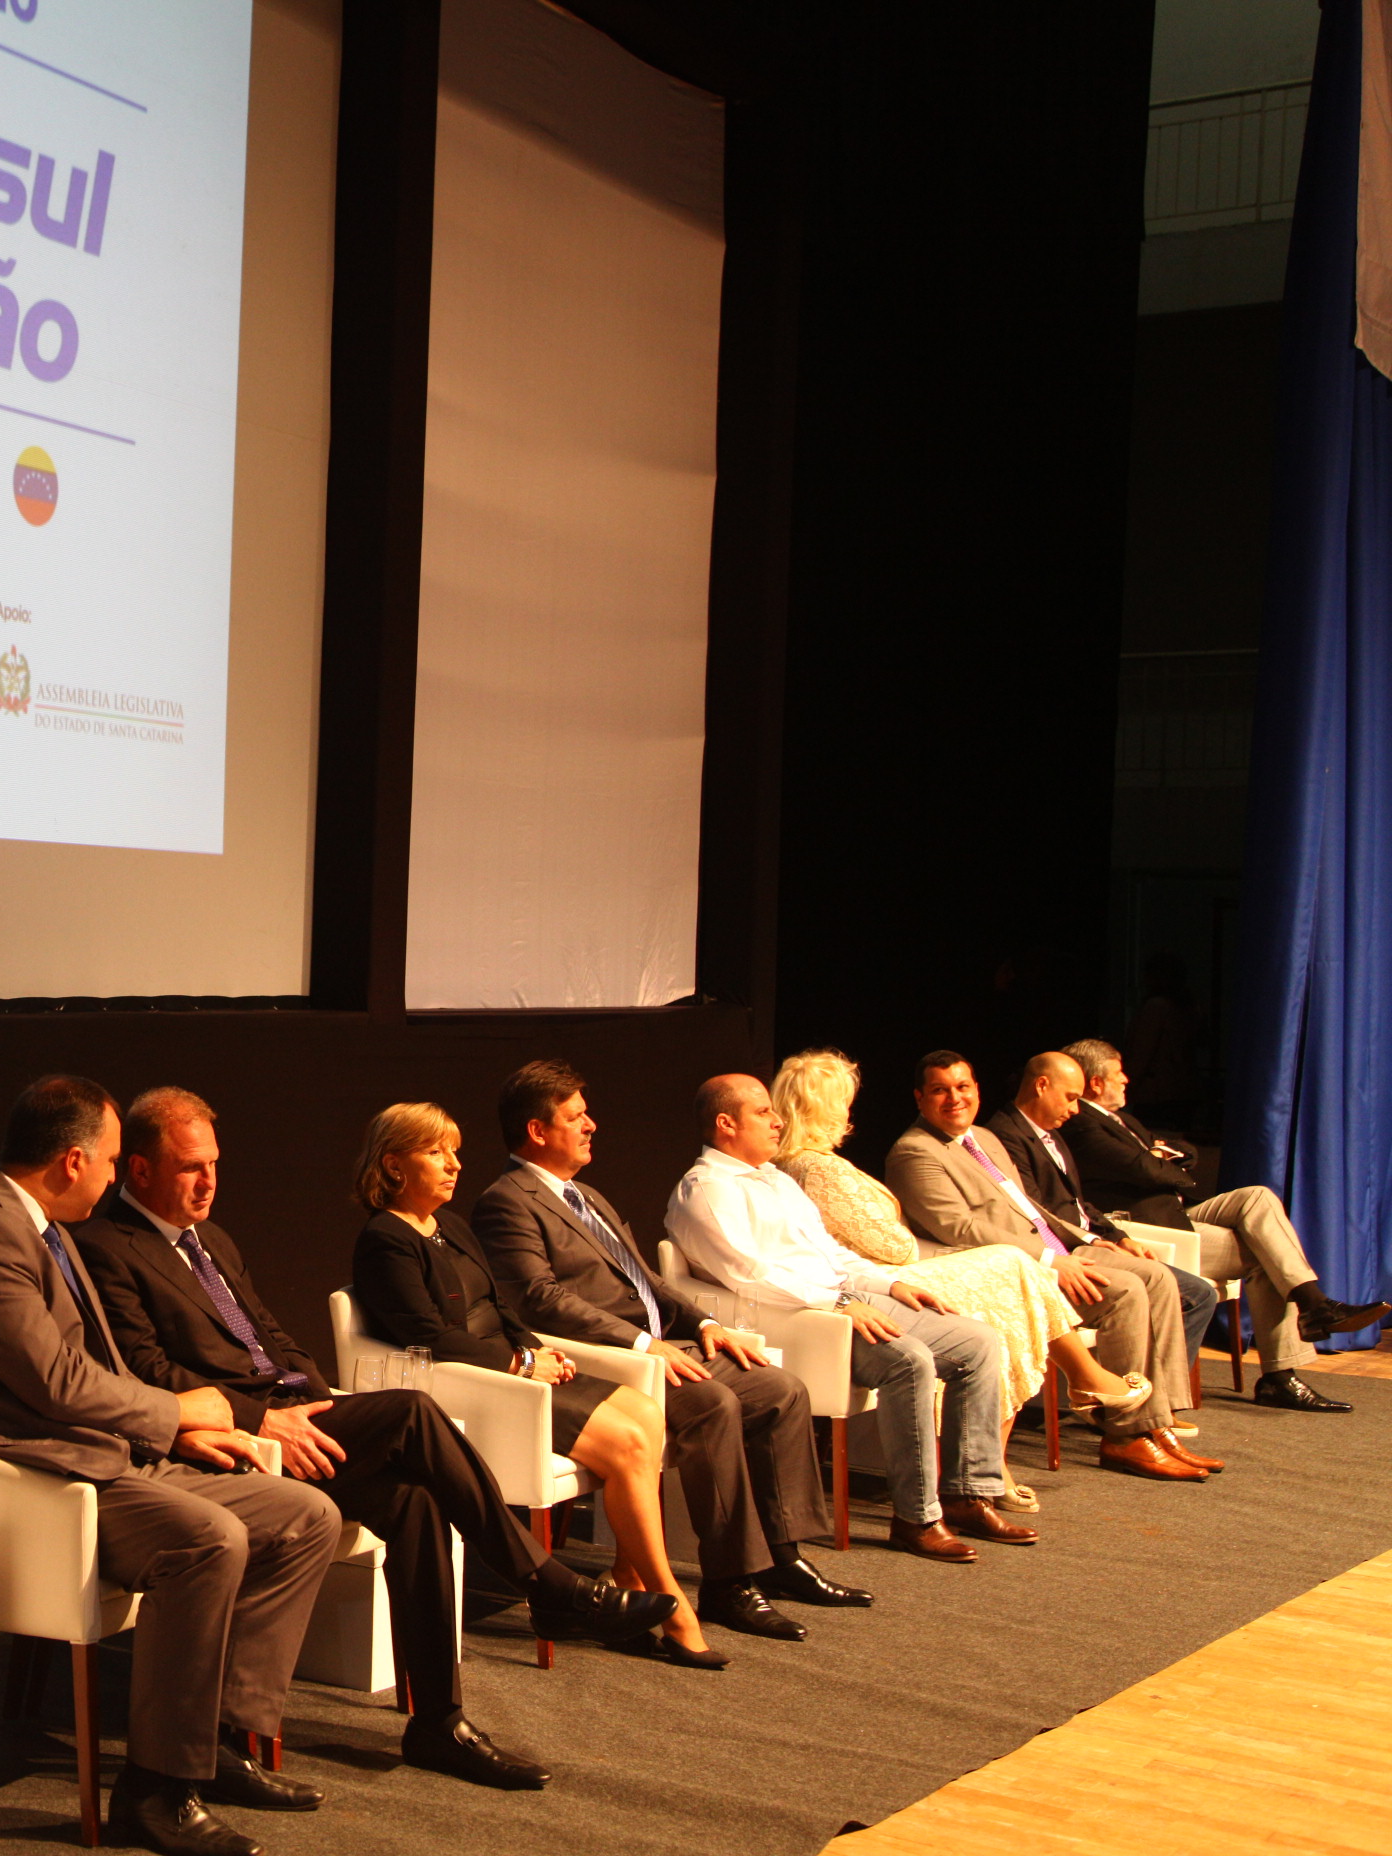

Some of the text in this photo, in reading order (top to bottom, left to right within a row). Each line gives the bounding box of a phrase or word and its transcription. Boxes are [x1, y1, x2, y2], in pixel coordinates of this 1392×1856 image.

[36, 683, 184, 719] ASSEMBLEIA LEGISLATIVA
[34, 713, 184, 745] DO ESTADO DE SANTA CATARINA
